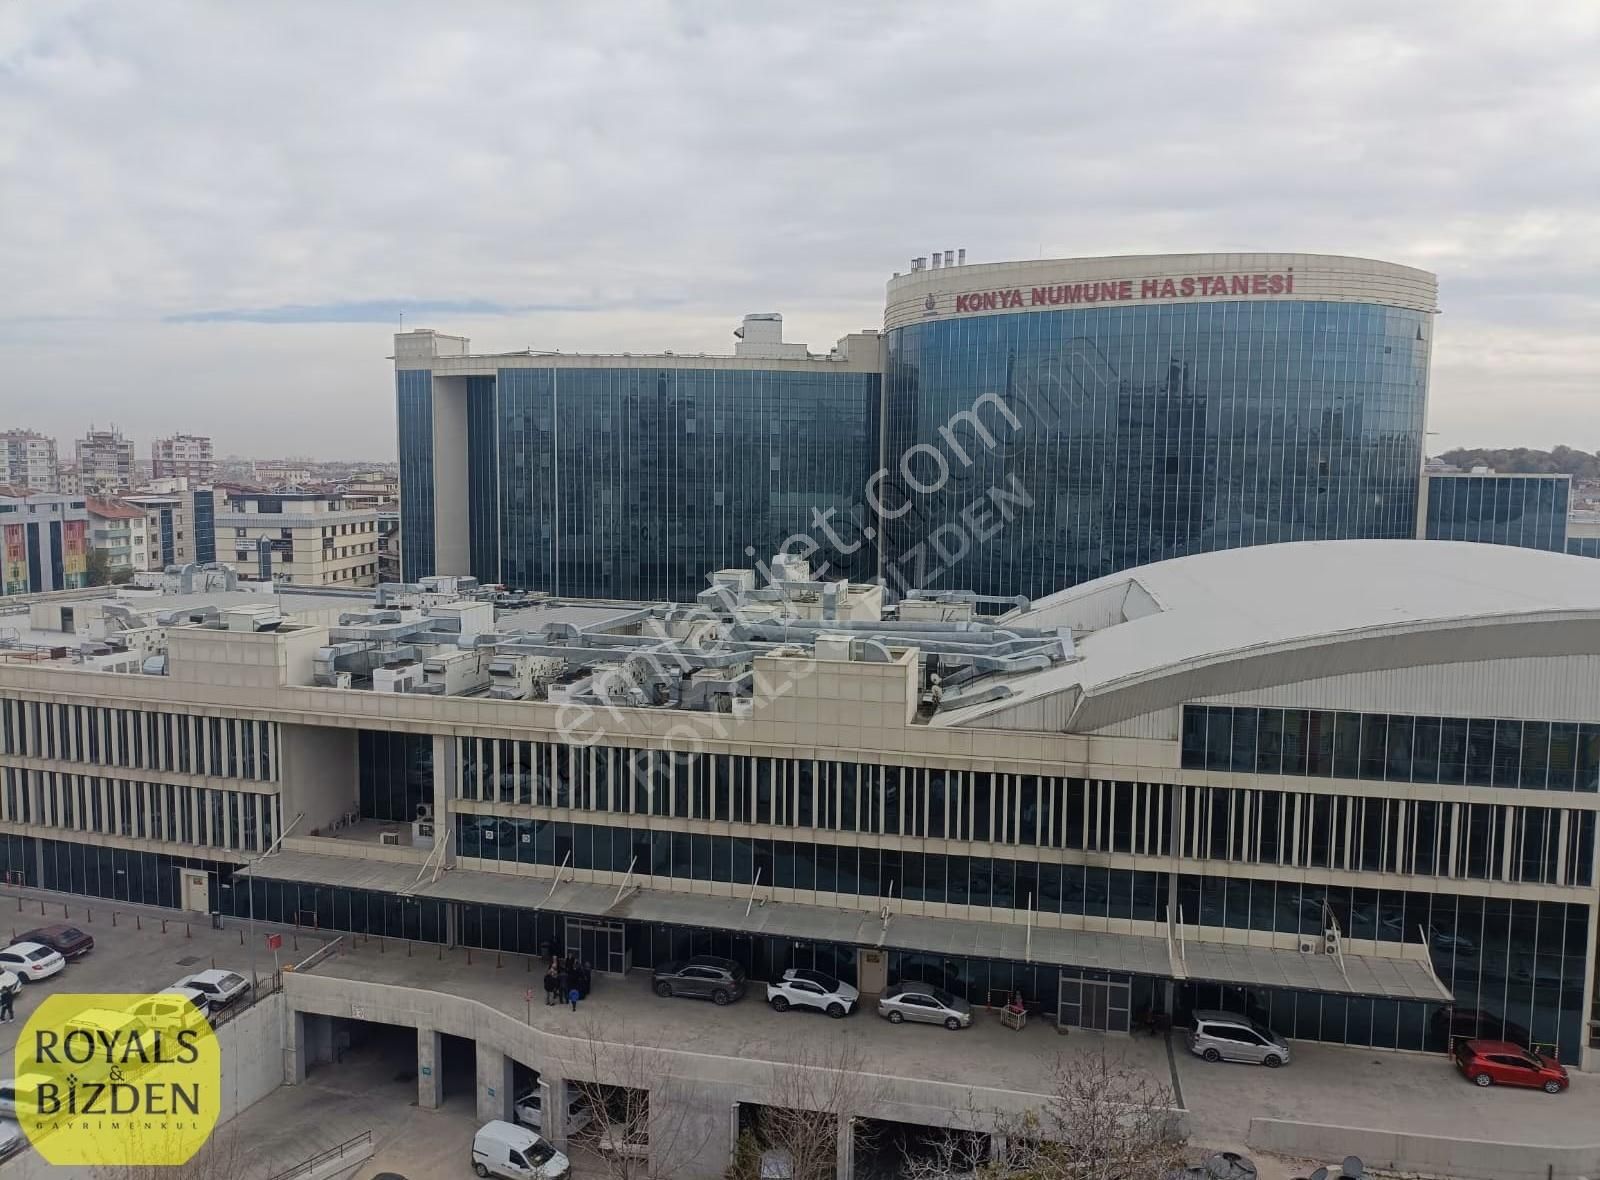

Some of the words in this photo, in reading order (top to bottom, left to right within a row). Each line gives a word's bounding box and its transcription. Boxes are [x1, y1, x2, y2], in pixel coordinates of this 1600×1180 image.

[956, 289, 1025, 313] KONYA
[1031, 280, 1133, 307] NUMUNE
[1141, 267, 1294, 298] HASTANESİ
